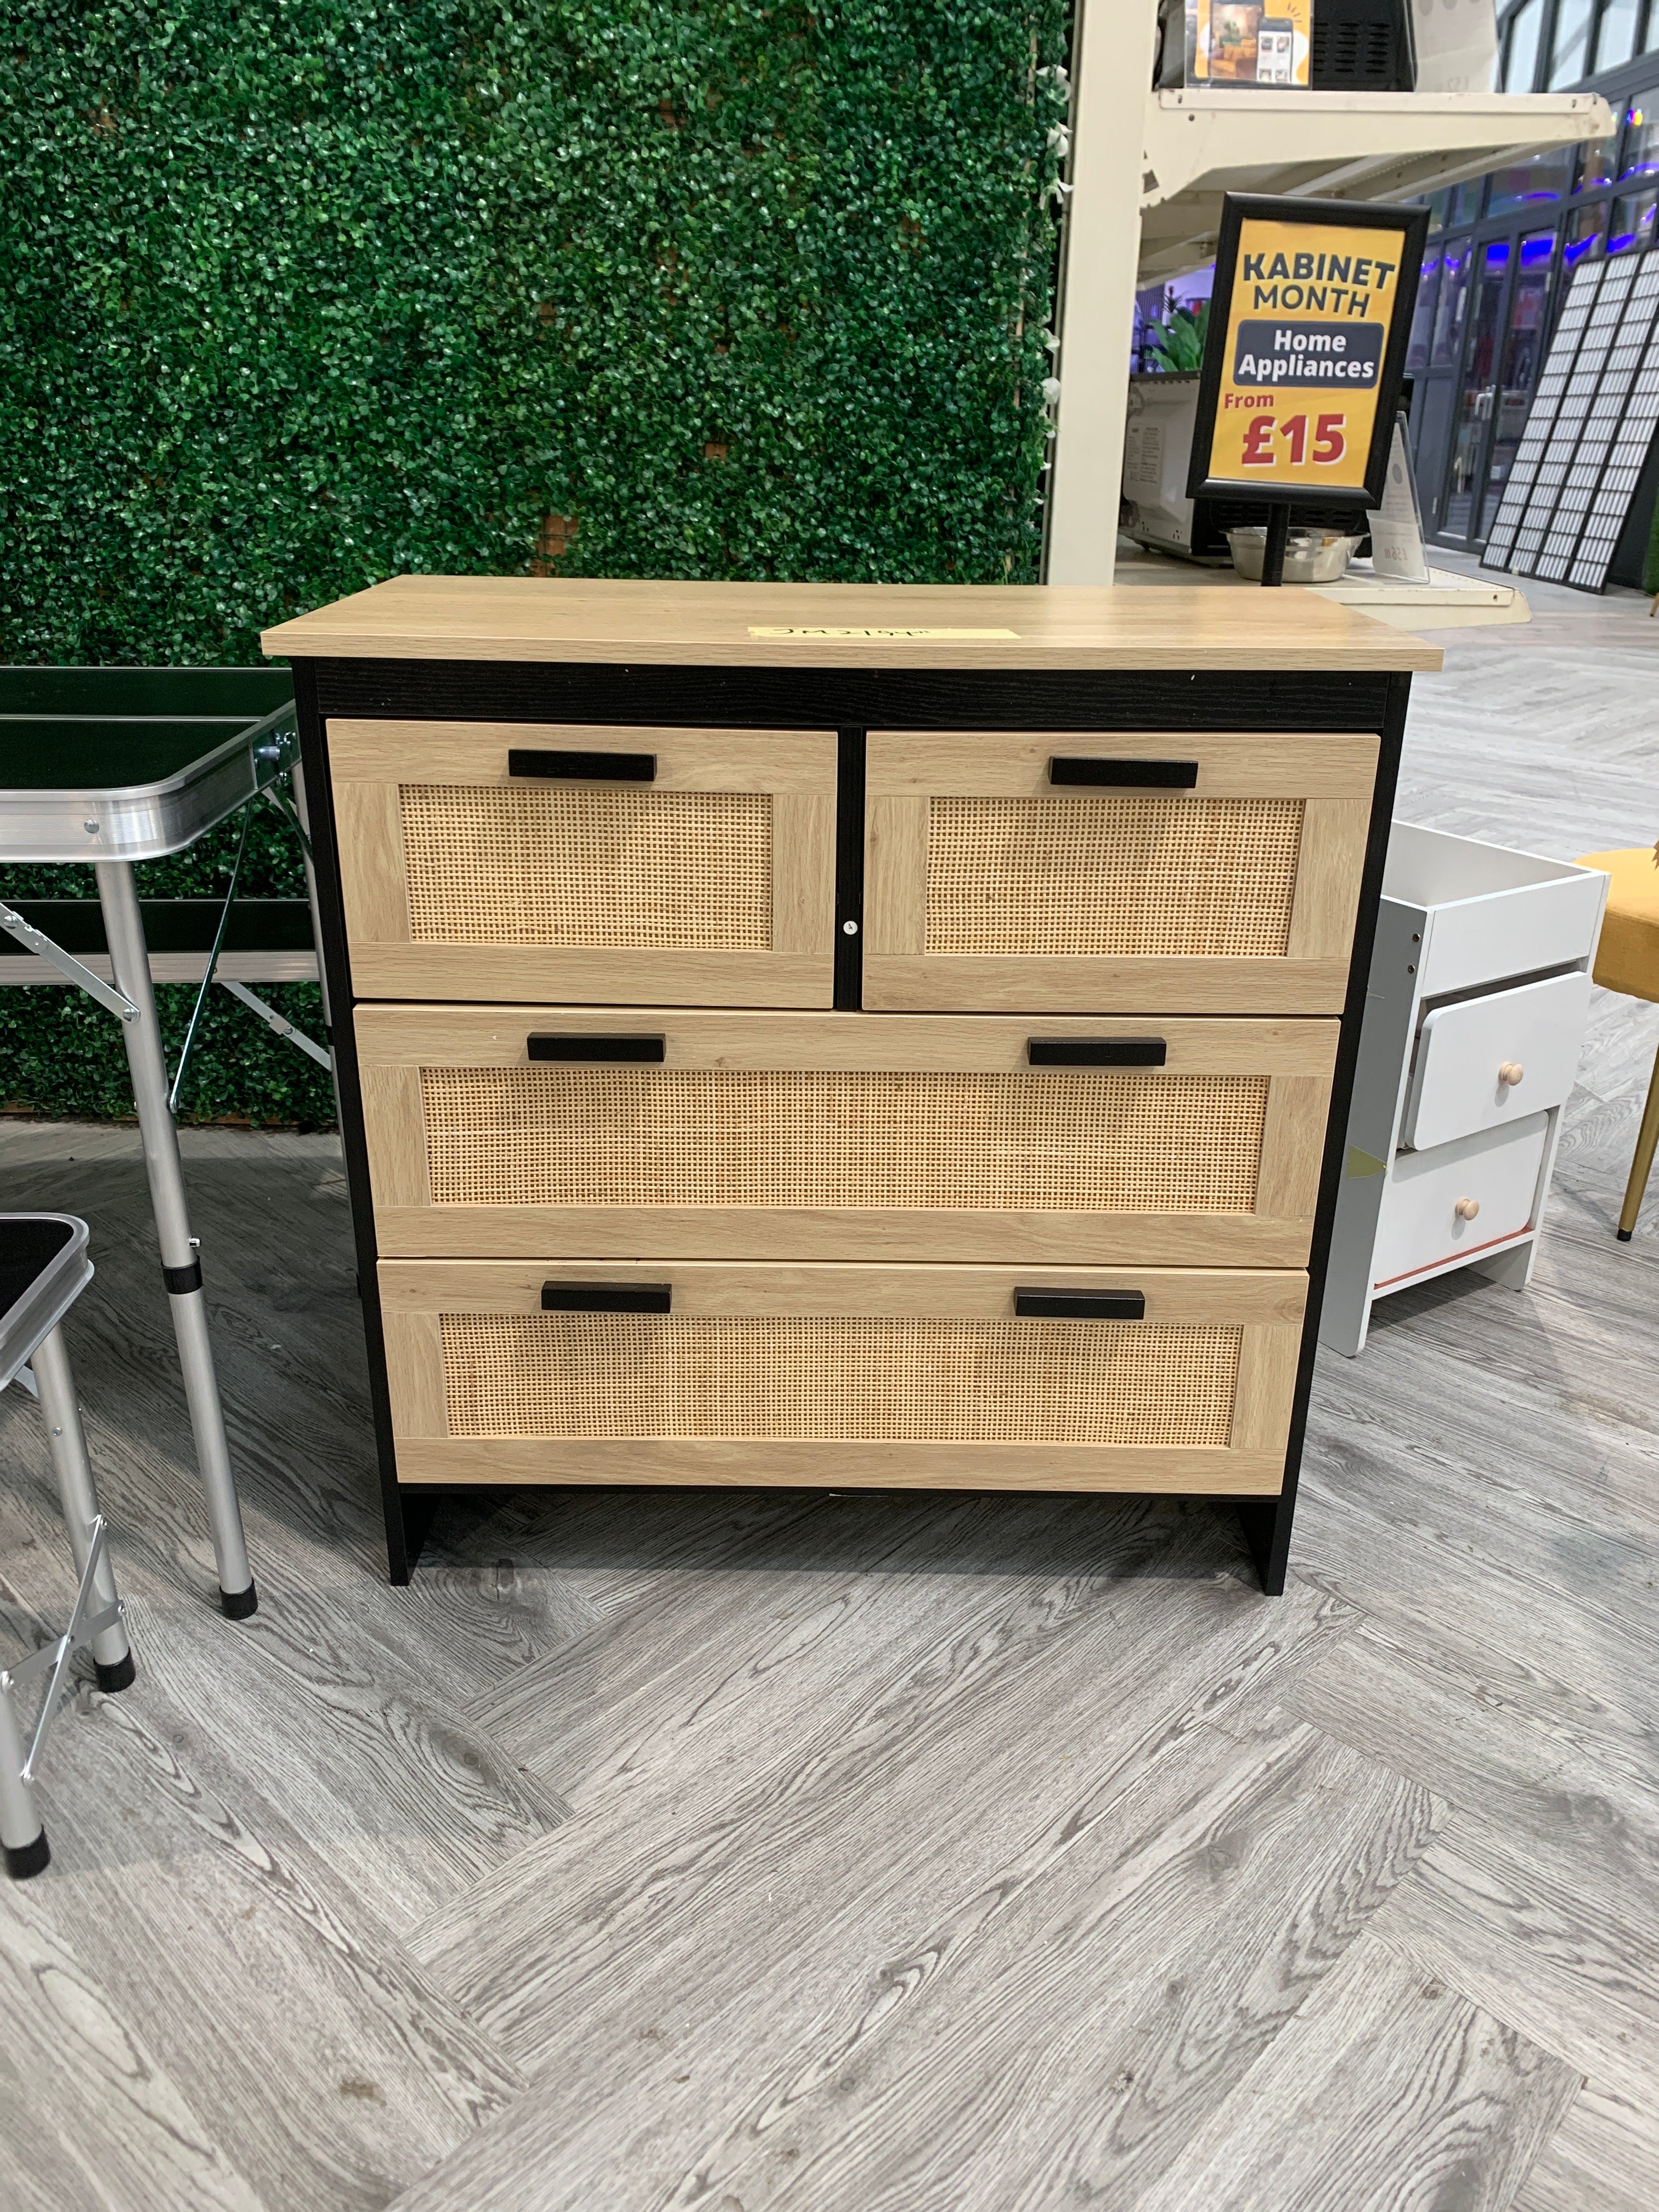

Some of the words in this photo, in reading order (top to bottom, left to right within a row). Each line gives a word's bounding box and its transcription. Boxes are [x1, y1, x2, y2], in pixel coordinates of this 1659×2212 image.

[1243, 252, 1396, 290] KABINET
[1254, 285, 1370, 318] MONTH
[1274, 329, 1347, 352] Home
[1238, 354, 1375, 382] Appliances
[1224, 393, 1274, 409] From
[1242, 413, 1346, 466] £15
